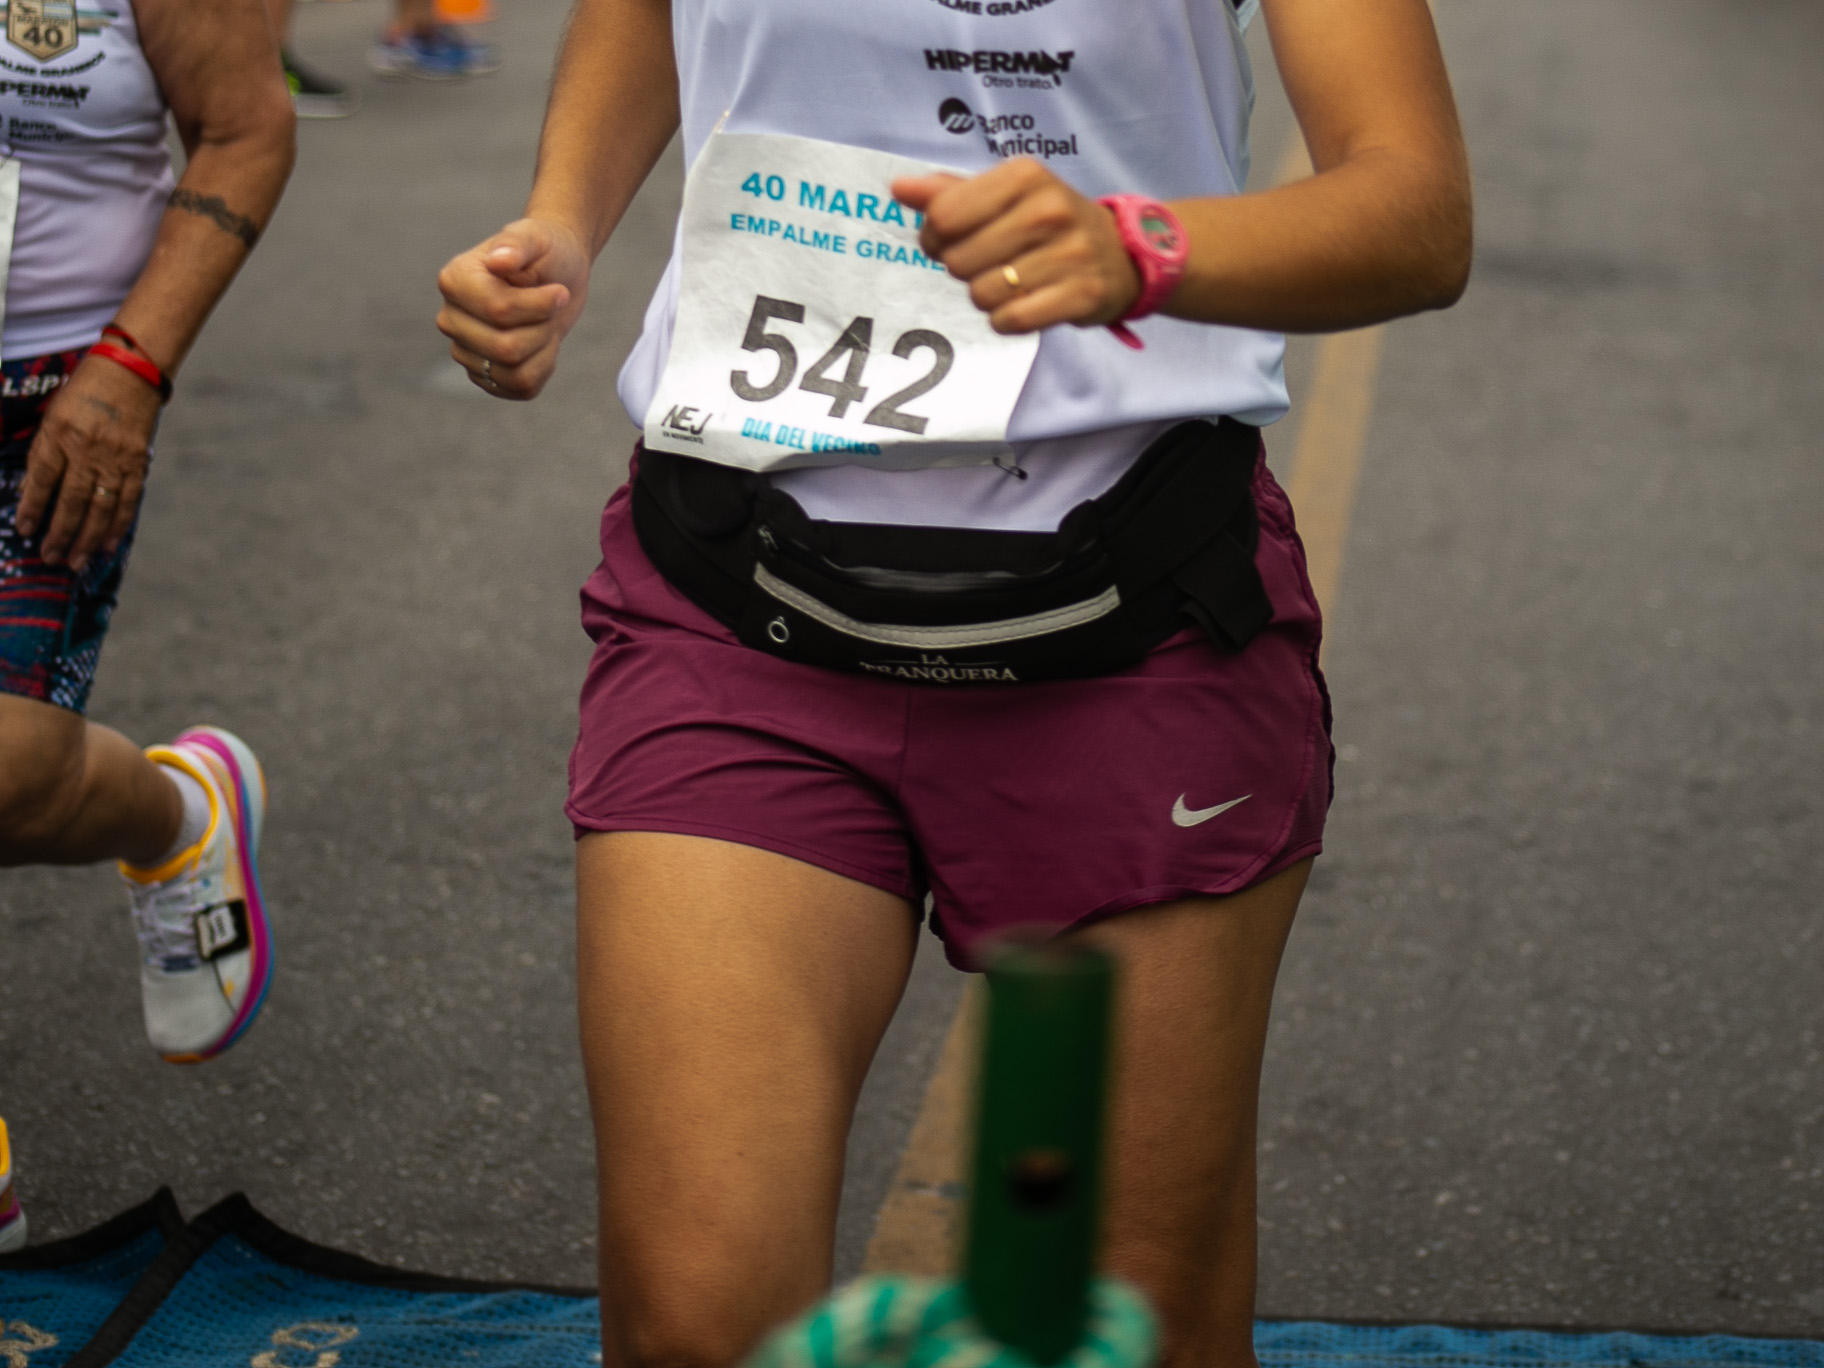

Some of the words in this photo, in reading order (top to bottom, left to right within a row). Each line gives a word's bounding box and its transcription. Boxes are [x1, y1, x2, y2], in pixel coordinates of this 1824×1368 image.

[23, 26, 63, 48] 40
[982, 74, 1014, 88] Otro
[741, 172, 786, 202] 40
[730, 213, 847, 254] EMPALME
[730, 293, 955, 436] 542
[661, 404, 713, 435] NEJ
[741, 417, 772, 443] DIA
[775, 424, 806, 451] DEL
[859, 660, 1019, 683] TRANQUERA
[921, 654, 949, 666] LA
